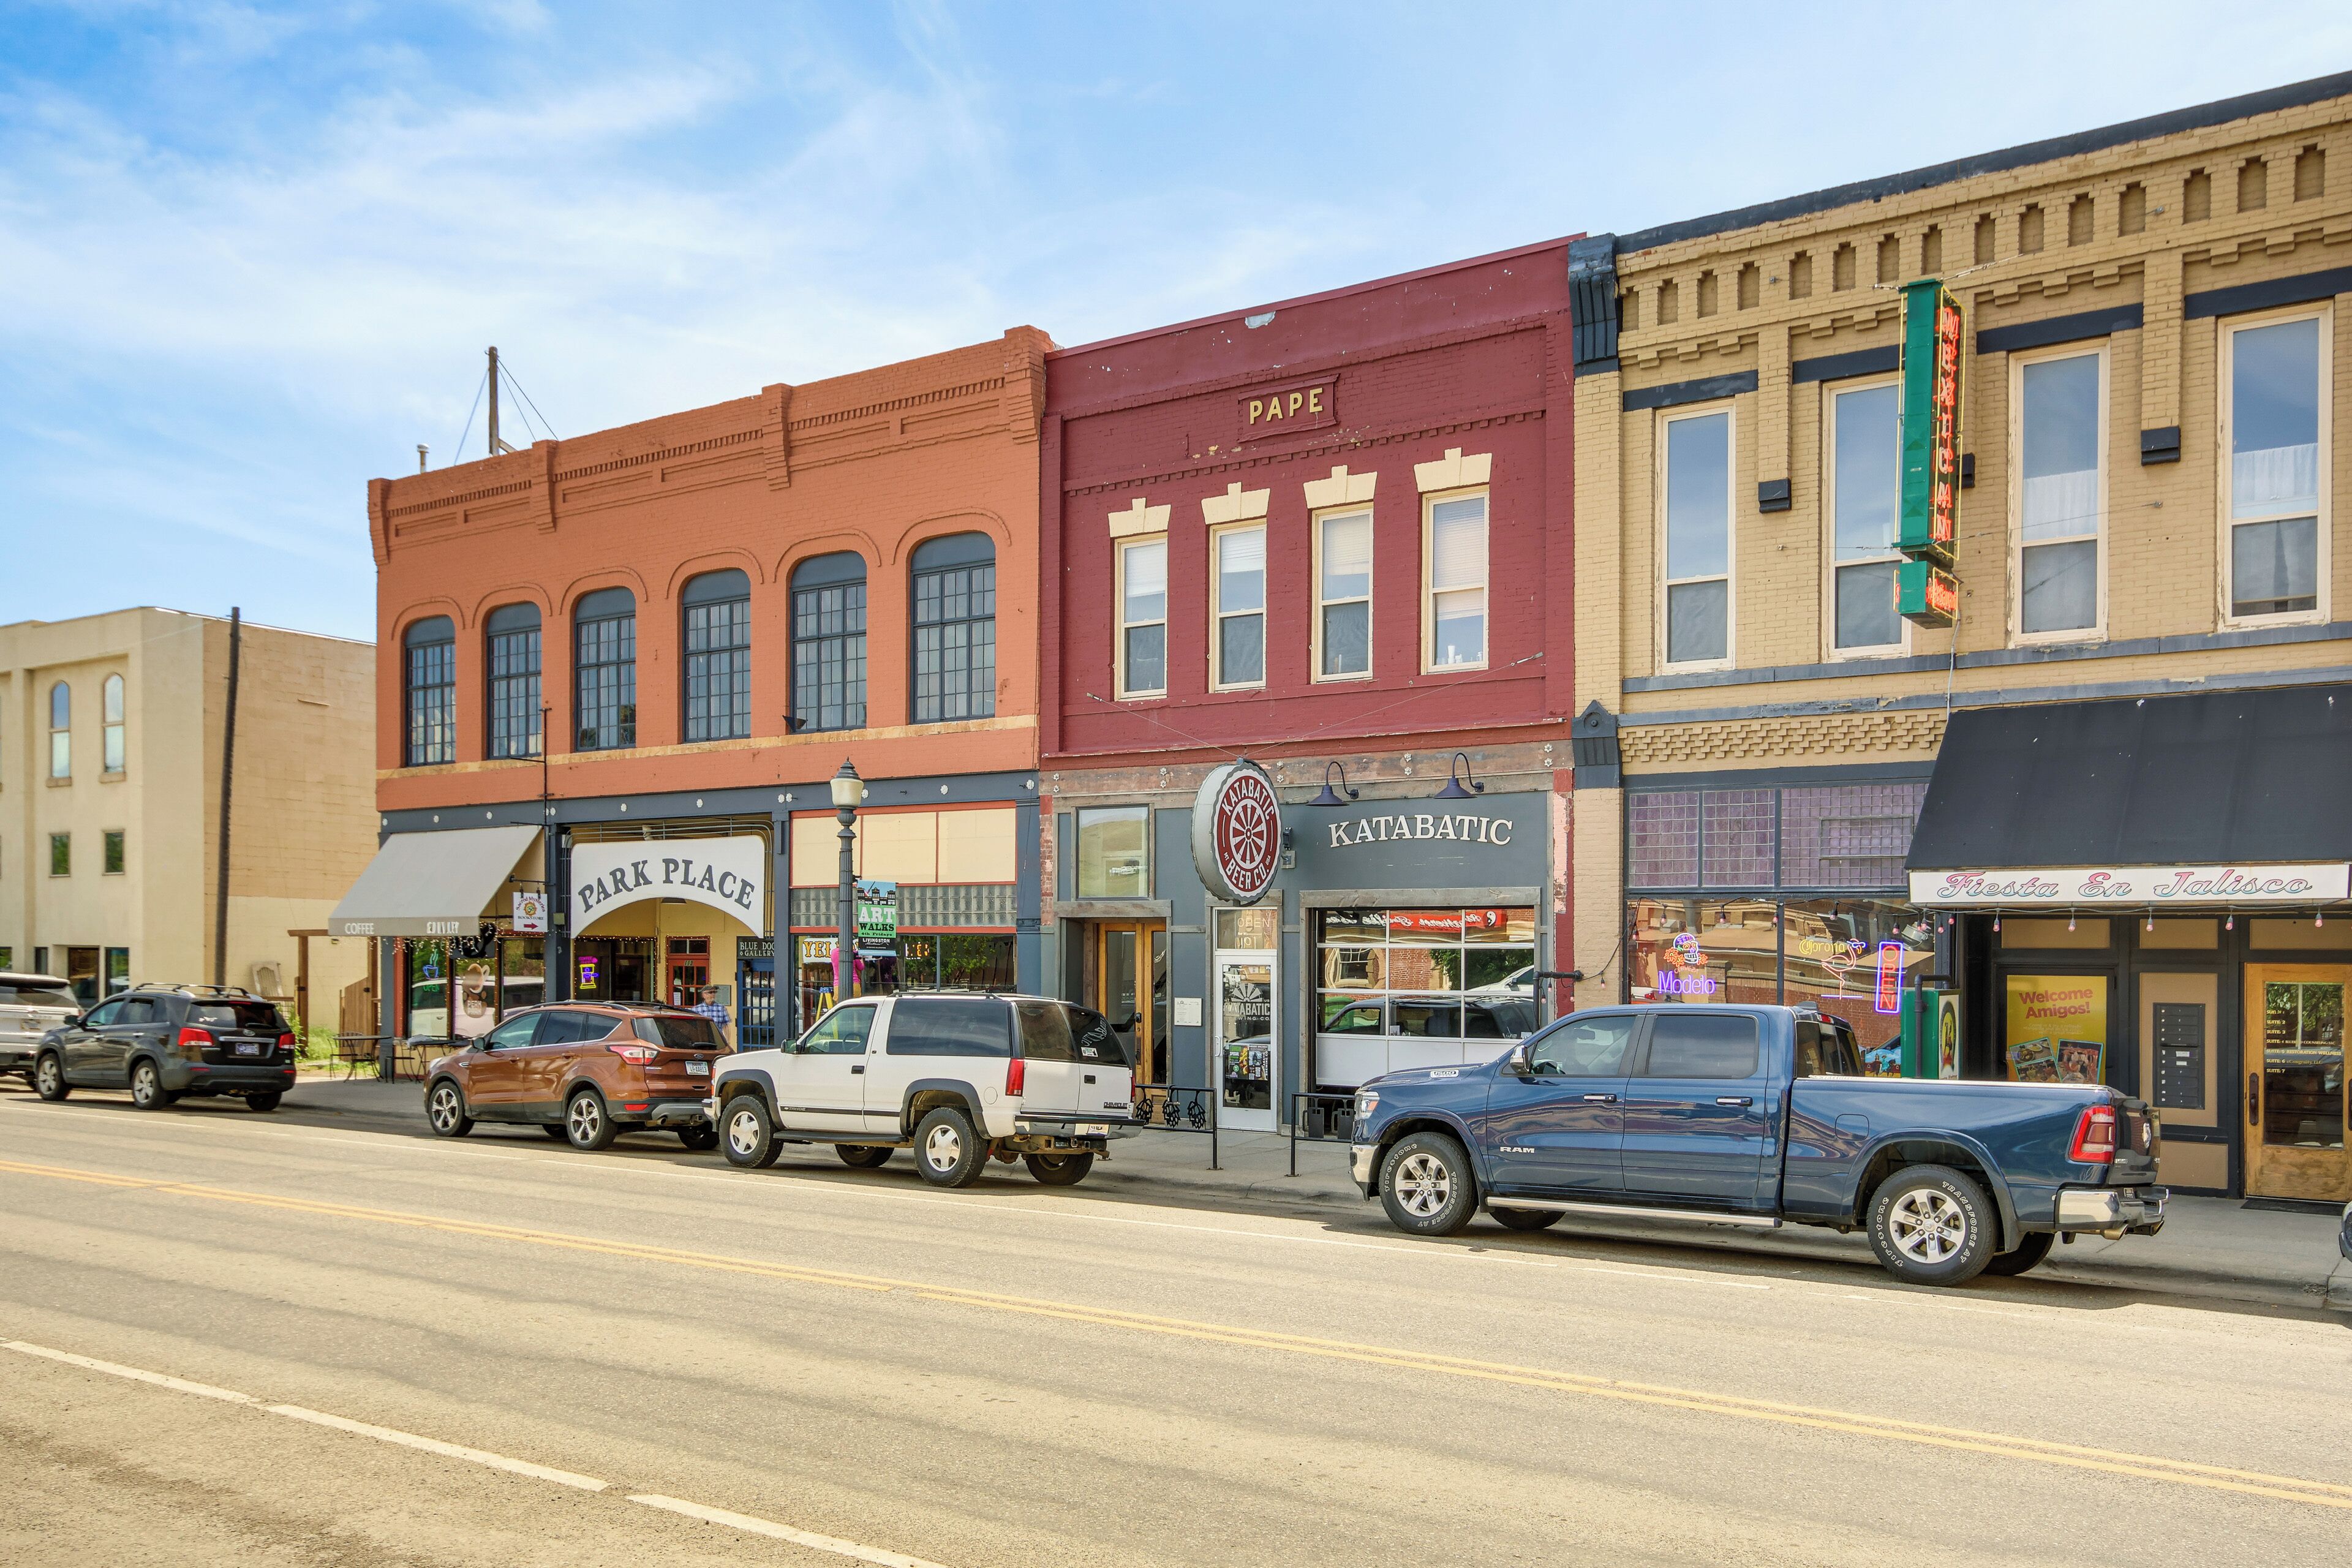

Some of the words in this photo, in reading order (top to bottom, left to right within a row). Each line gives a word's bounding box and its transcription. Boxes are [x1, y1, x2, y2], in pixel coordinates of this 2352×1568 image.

[1250, 388, 1323, 424] PAPE
[1222, 778, 1274, 820] KATABATIC
[1329, 814, 1513, 848] KATABATIC
[1224, 852, 1230, 861] MT
[578, 860, 652, 913] PARK
[662, 858, 755, 910] PLACE
[1226, 858, 1251, 889] BEER
[1255, 862, 1269, 886] CO.
[1937, 872, 2059, 898] Fiesta
[2078, 872, 2132, 897] En
[2154, 869, 2313, 897] Jalisco
[516, 897, 528, 911] Sacred
[529, 896, 546, 912] Mysteries
[859, 907, 895, 922] ART
[345, 923, 374, 935] COFFEE
[859, 922, 894, 931] WALKS
[1800, 939, 1845, 954] Corona
[1659, 971, 1716, 994] Modelo
[1880, 945, 1899, 1009] OPEN
[2019, 989, 2093, 1005] Welcome
[2026, 1001, 2090, 1019] Amigos!
[1384, 1144, 1417, 1193] Firestone
[1431, 1171, 1458, 1225] TRANSFORCE
[1876, 1197, 1904, 1267] Firestone
[1942, 1181, 1978, 1248] TRANSFORCE
[1960, 1248, 1971, 1264] AT
